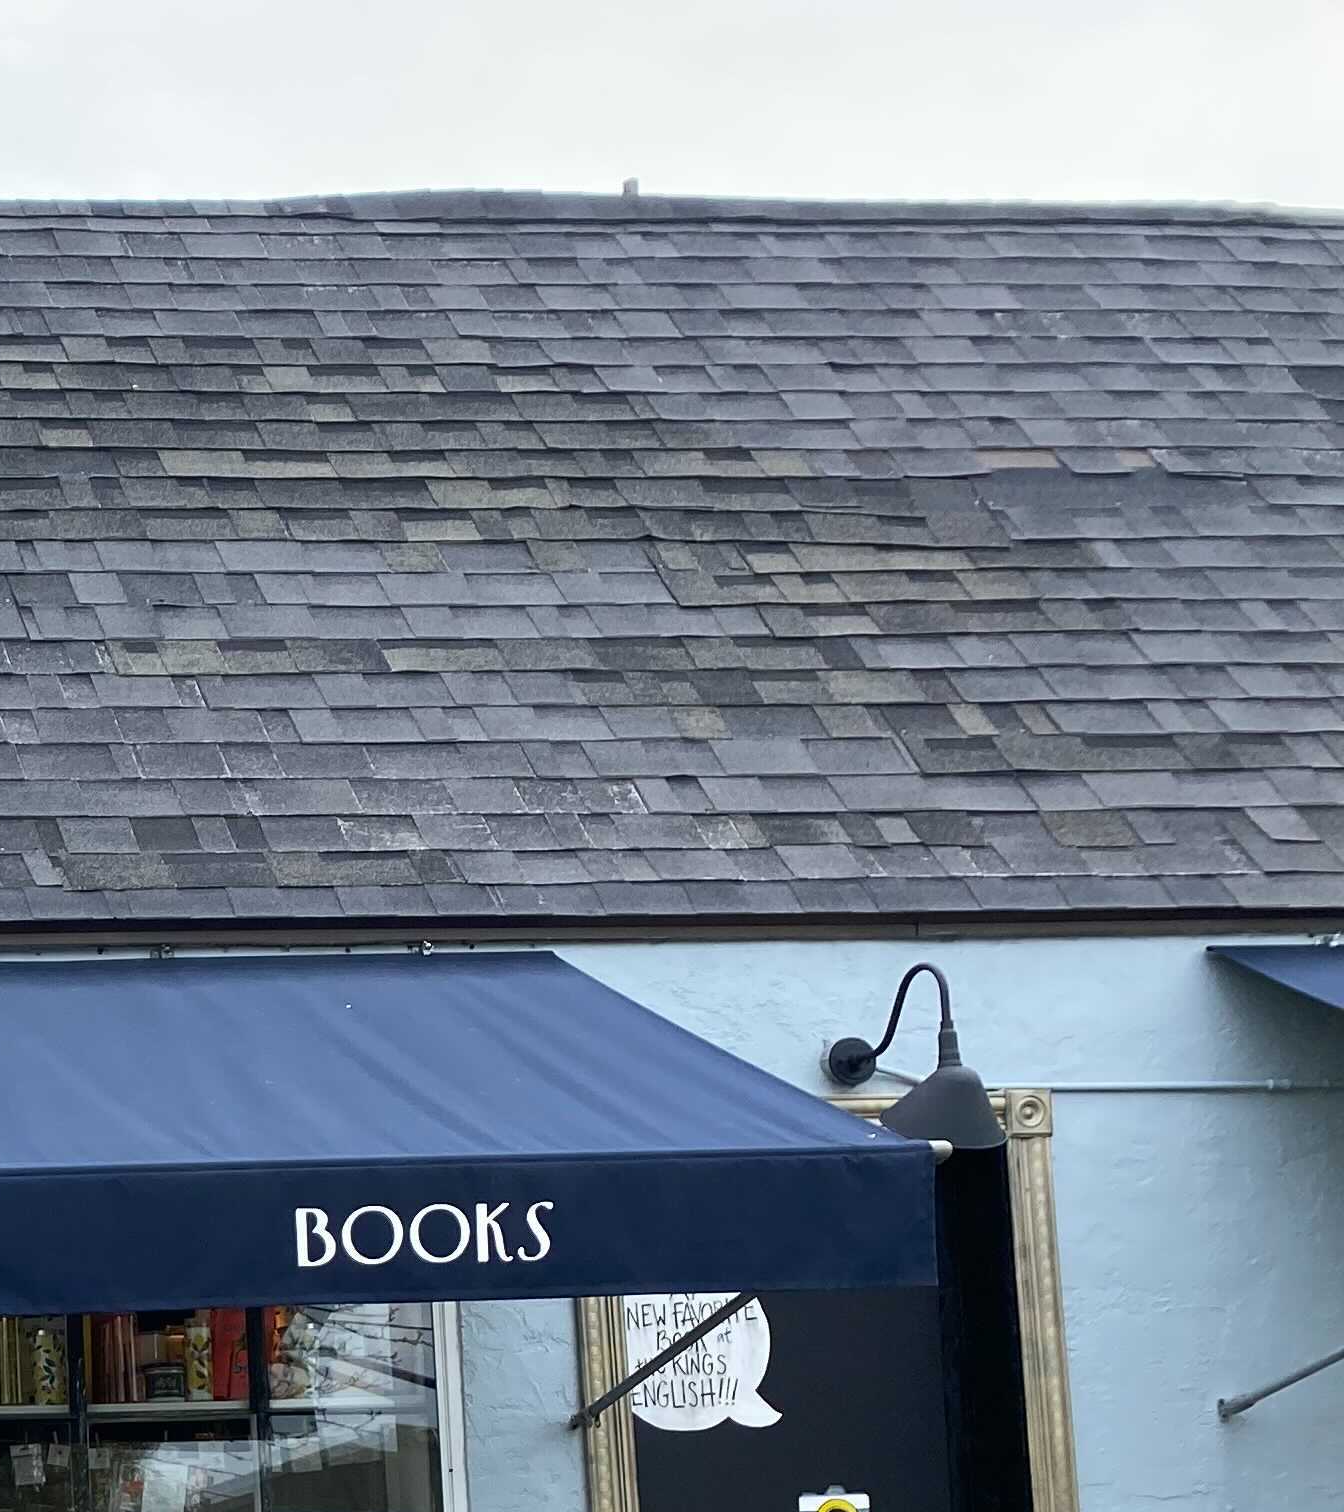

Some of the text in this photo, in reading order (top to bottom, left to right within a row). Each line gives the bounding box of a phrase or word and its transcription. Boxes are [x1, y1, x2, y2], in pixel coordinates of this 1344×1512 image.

[295, 1201, 554, 1267] BOOKS
[626, 1302, 666, 1330] NEW
[672, 1354, 727, 1376] KINGS
